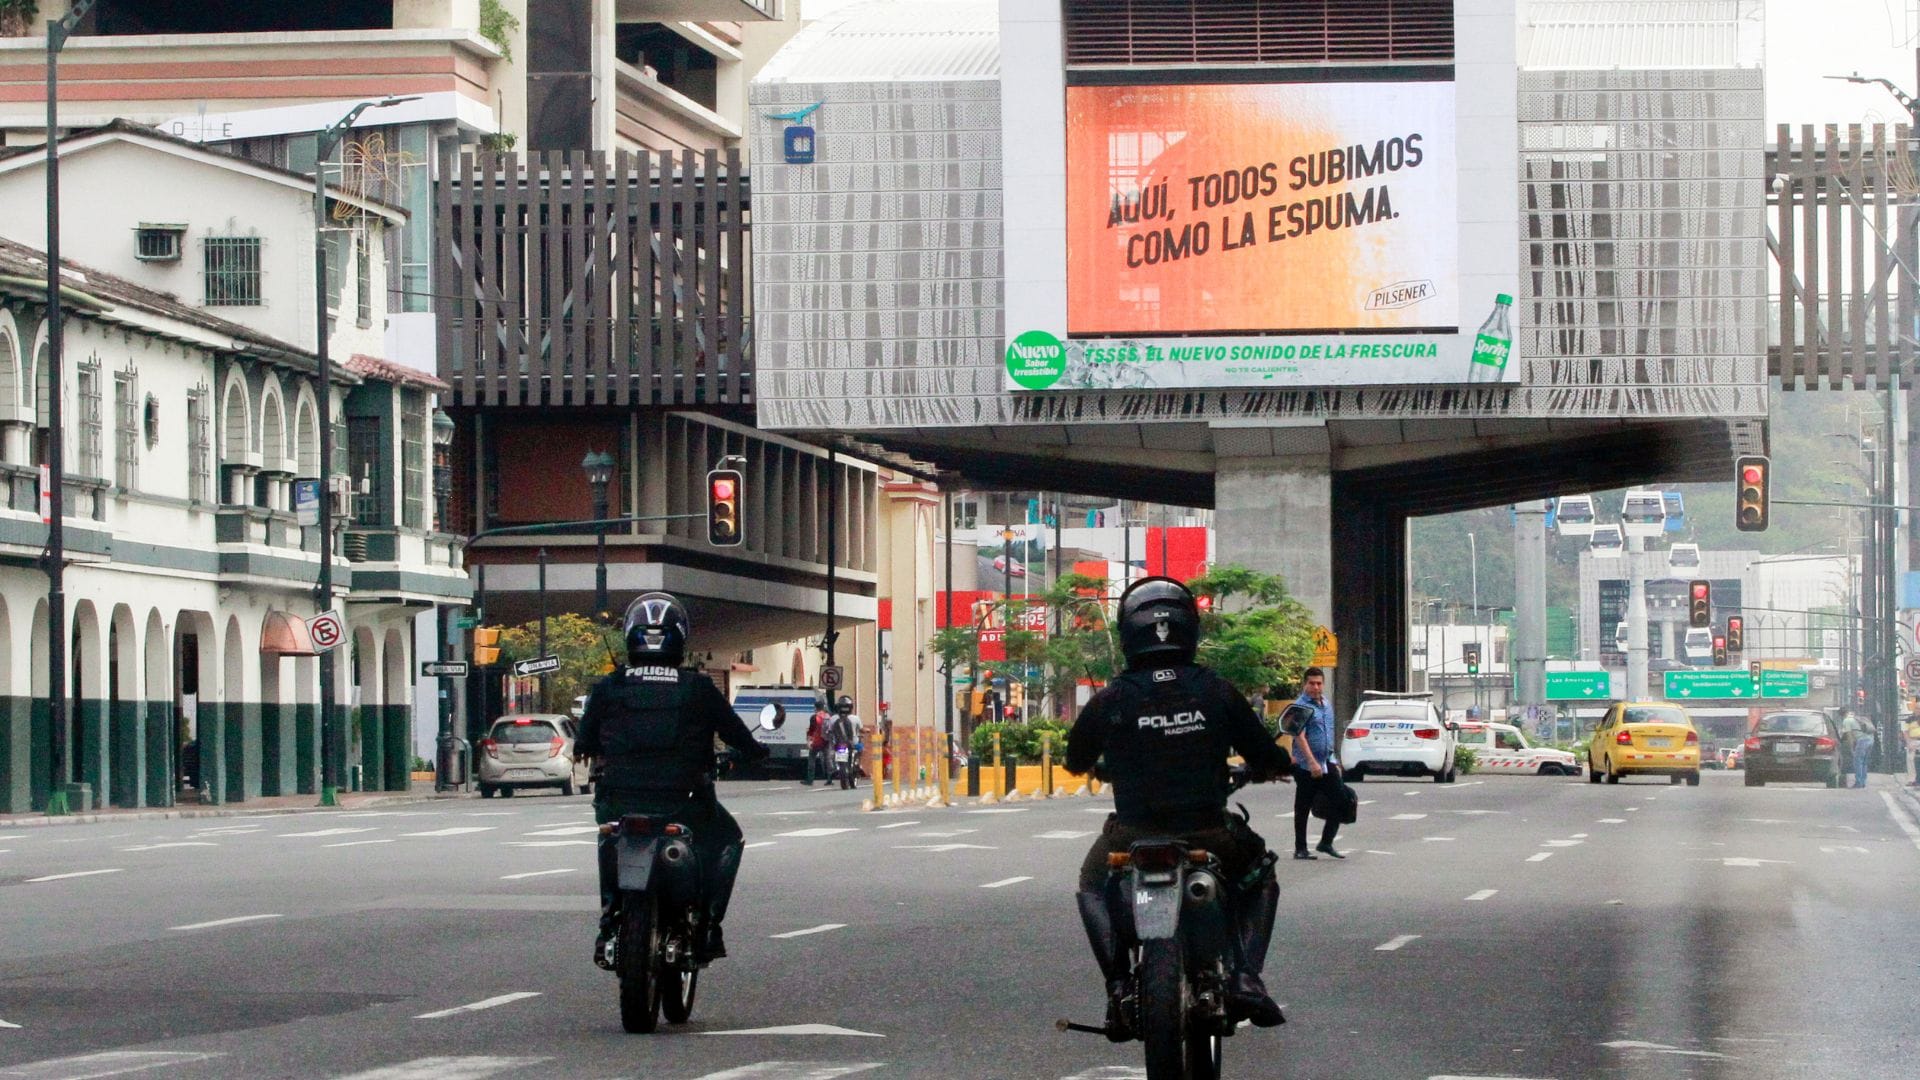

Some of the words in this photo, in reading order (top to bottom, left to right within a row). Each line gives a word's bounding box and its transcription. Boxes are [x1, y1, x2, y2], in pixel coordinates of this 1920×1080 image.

[1107, 175, 1175, 229] AQUÍ,
[1188, 162, 1277, 211] TODOS
[1288, 133, 1423, 191] SUBIMOS
[1126, 221, 1210, 268] COMO
[1222, 212, 1256, 252] LA
[1268, 185, 1400, 242] ESPUMA.
[1374, 283, 1427, 307] PILSENER
[1011, 342, 1060, 360] Nuevo
[1146, 346, 1164, 361] EL
[1169, 345, 1226, 361] NUEVO
[1300, 344, 1321, 360] DE
[1324, 344, 1346, 359] LA
[1349, 343, 1438, 359] FRESCURA
[1476, 339, 1508, 357] Sprite
[1014, 367, 1058, 377] Irresistible
[1024, 359, 1049, 368] Sabor
[625, 666, 679, 677] POLICIA
[1138, 710, 1206, 729] POLICIA
[1164, 723, 1205, 736] NACIONAL
